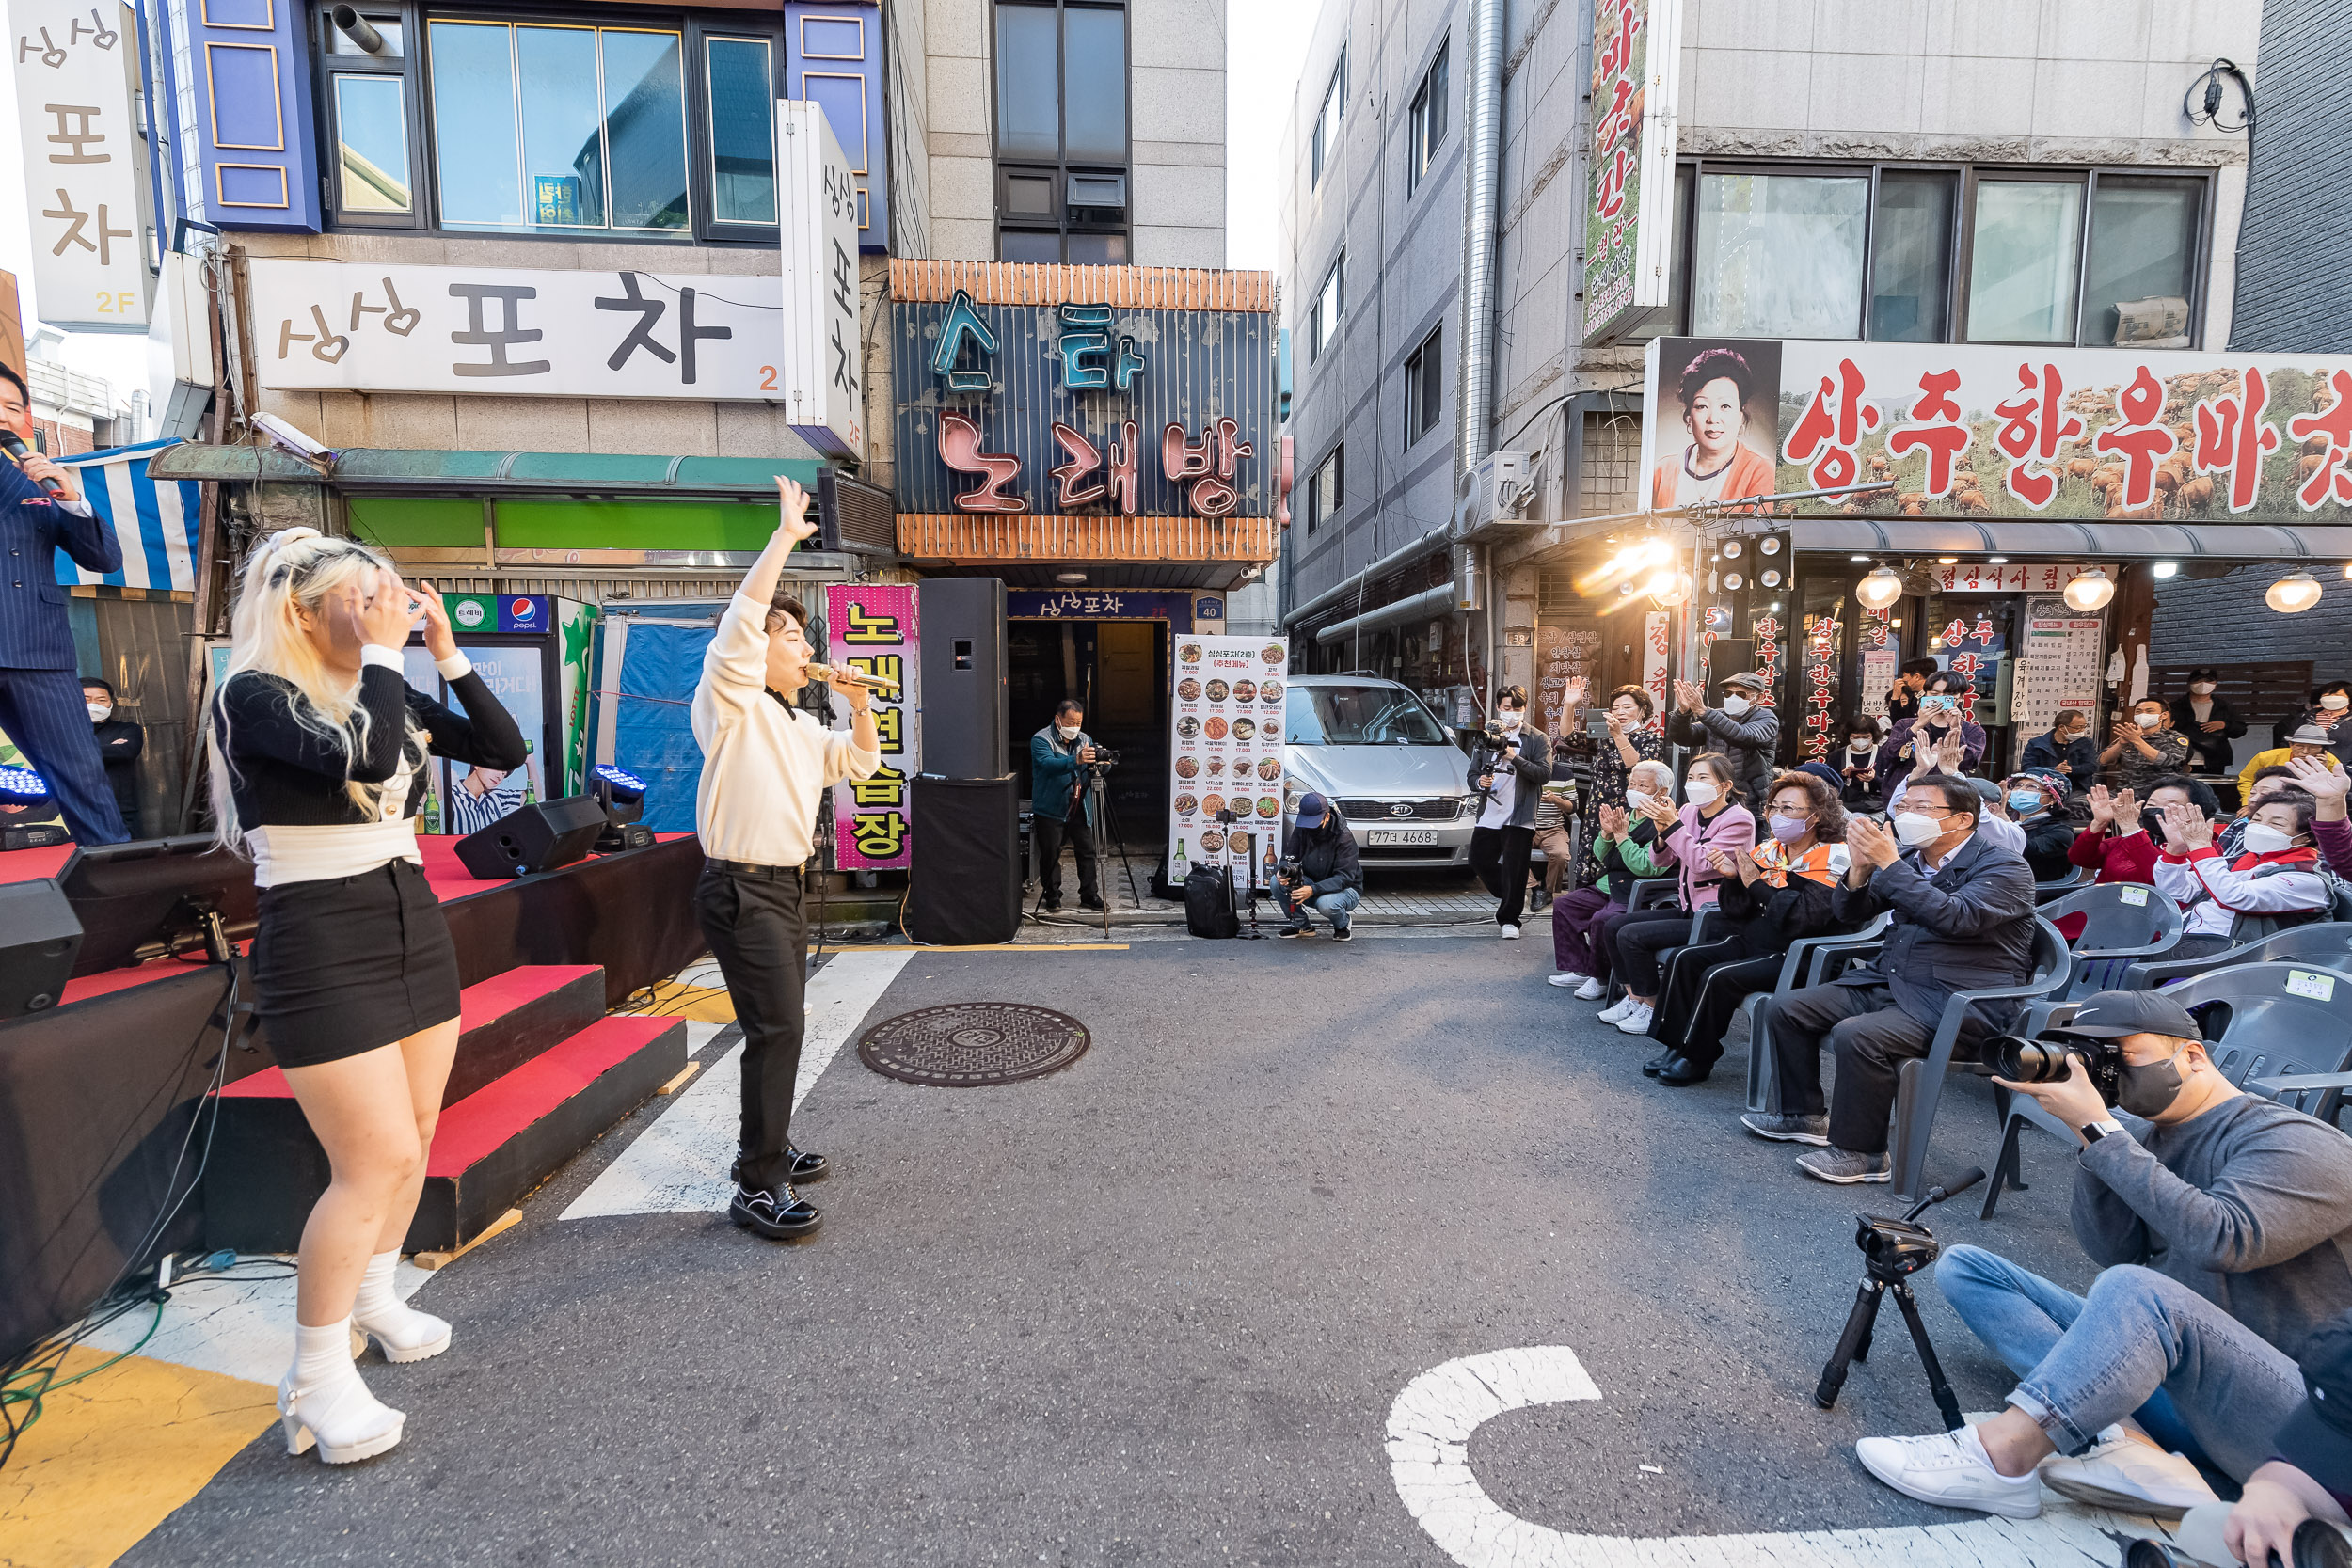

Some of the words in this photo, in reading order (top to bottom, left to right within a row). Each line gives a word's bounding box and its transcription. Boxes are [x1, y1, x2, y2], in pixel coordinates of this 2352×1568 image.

[96, 292, 135, 314] 2F
[279, 271, 733, 385] 상상포차
[931, 289, 1149, 394] 스타
[849, 420, 861, 448] 2F
[937, 410, 1254, 519] 노래방
[1479, 461, 1494, 475] SAMSUNG
[1940, 566, 2032, 590] 점심식사
[457, 609, 483, 618] 트레비
[1041, 592, 1124, 617] 상상포차
[1151, 608, 1167, 618] 2F
[1203, 608, 1216, 617] 40
[1941, 619, 1995, 647] 상주
[1213, 659, 1249, 668] (추천메뉴)
[1755, 617, 1784, 707] 한우암소
[568, 685, 580, 728] LOTTE
[1375, 832, 1397, 843] 77더
[1402, 832, 1432, 843] 4668
